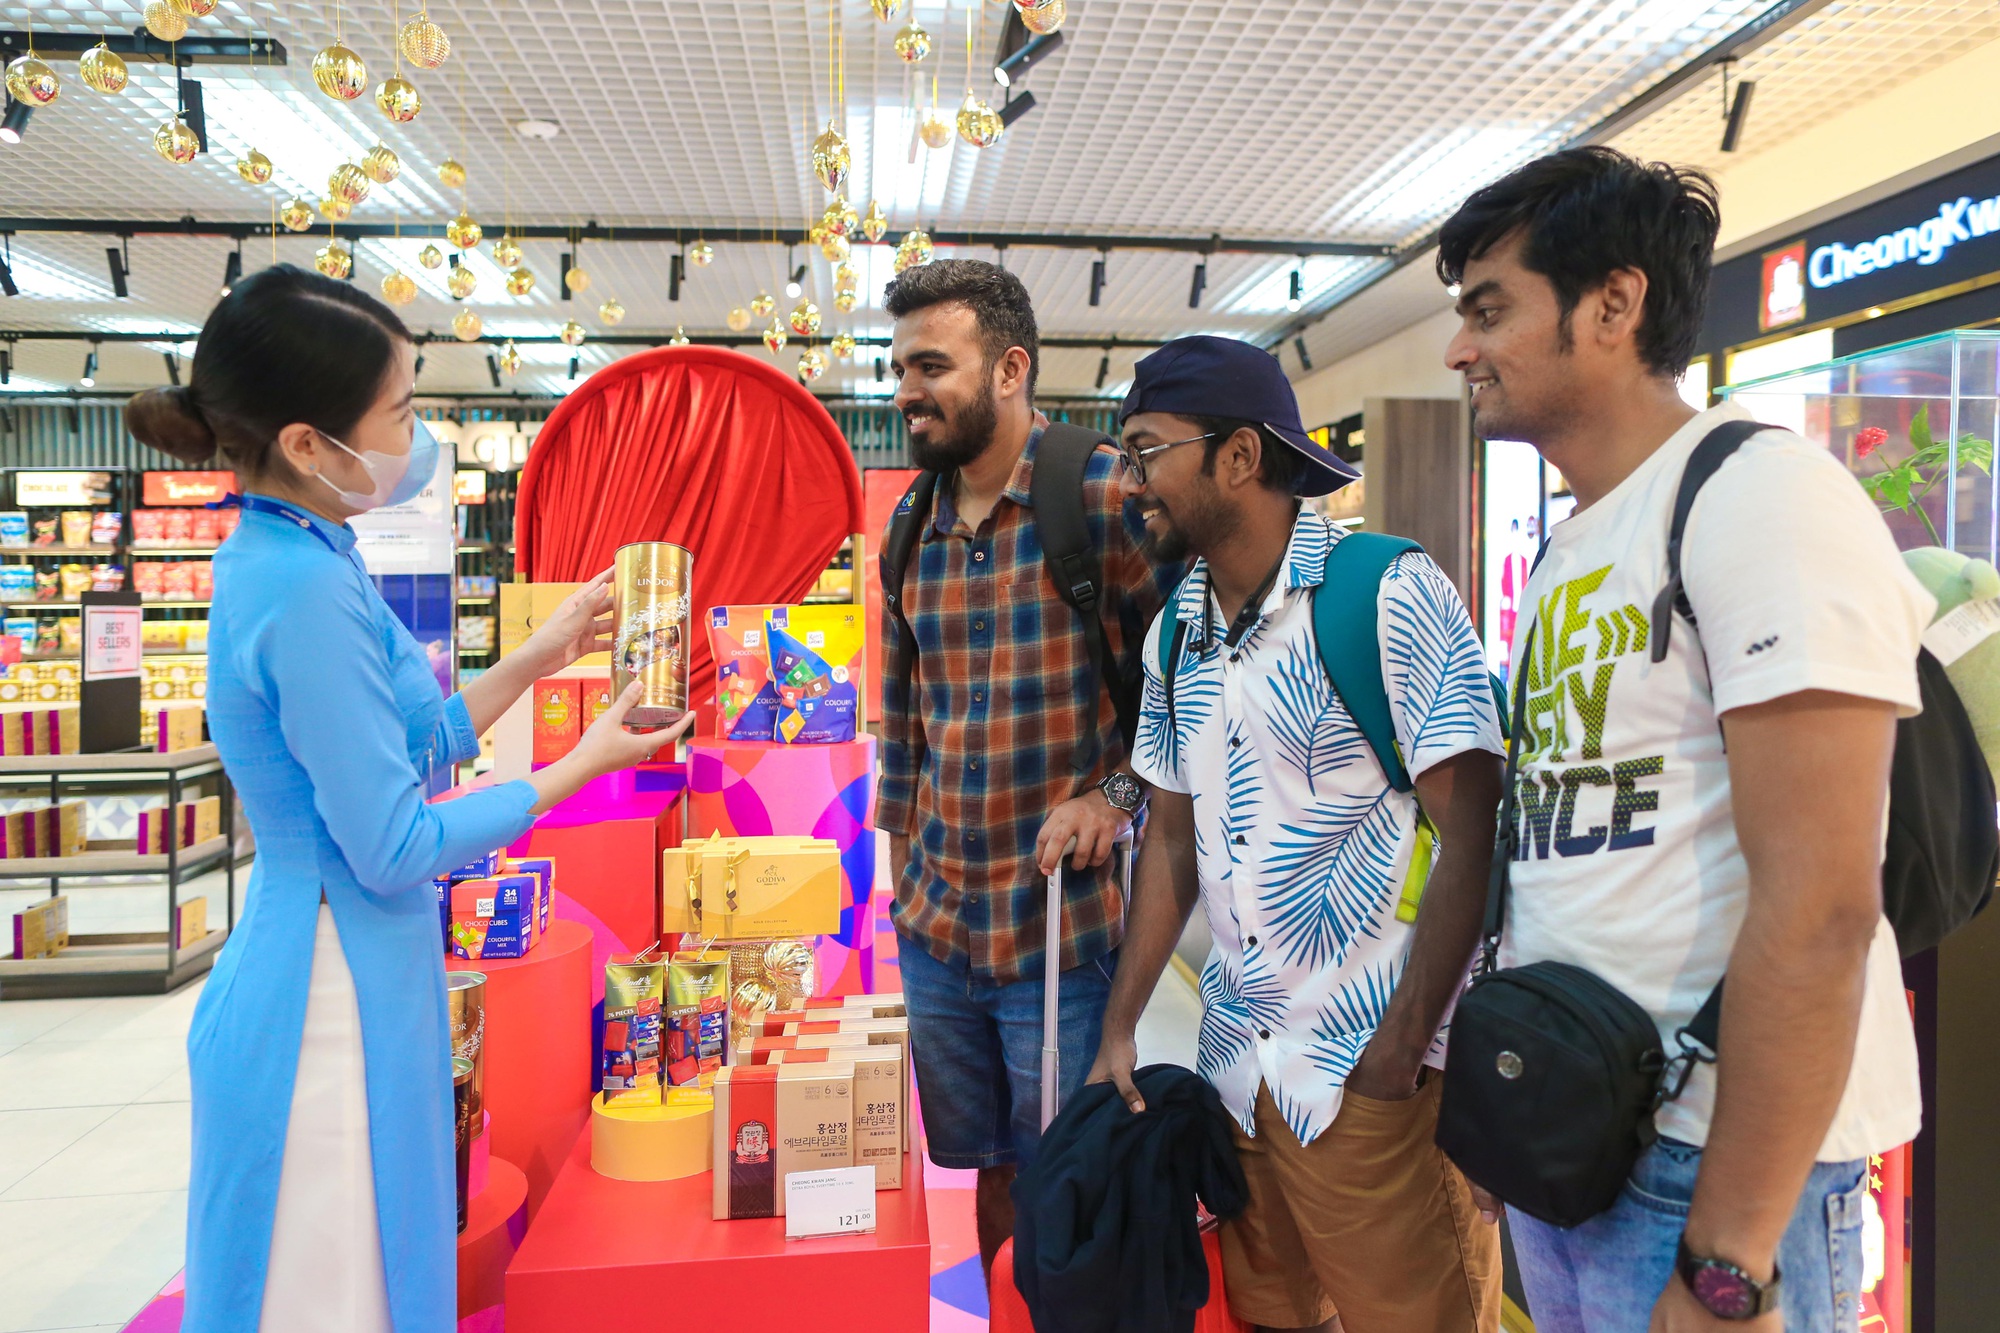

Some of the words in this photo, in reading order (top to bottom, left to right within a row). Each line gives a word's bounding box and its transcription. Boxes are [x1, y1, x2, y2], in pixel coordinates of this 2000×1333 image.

[637, 578, 676, 589] LINDOR
[105, 622, 125, 634] BEST
[98, 636, 131, 650] SELLERS
[504, 888, 517, 896] 34
[620, 977, 645, 986] Lindt
[682, 975, 707, 984] Lindt
[615, 1008, 634, 1017] PIECES
[678, 1006, 697, 1014] PIECES
[874, 1066, 880, 1075] 6
[825, 1085, 831, 1094] 6
[866, 1102, 895, 1115] 홍삼정
[816, 1122, 847, 1135] 홍삼정
[784, 1135, 847, 1148] 에브리타임로얄
